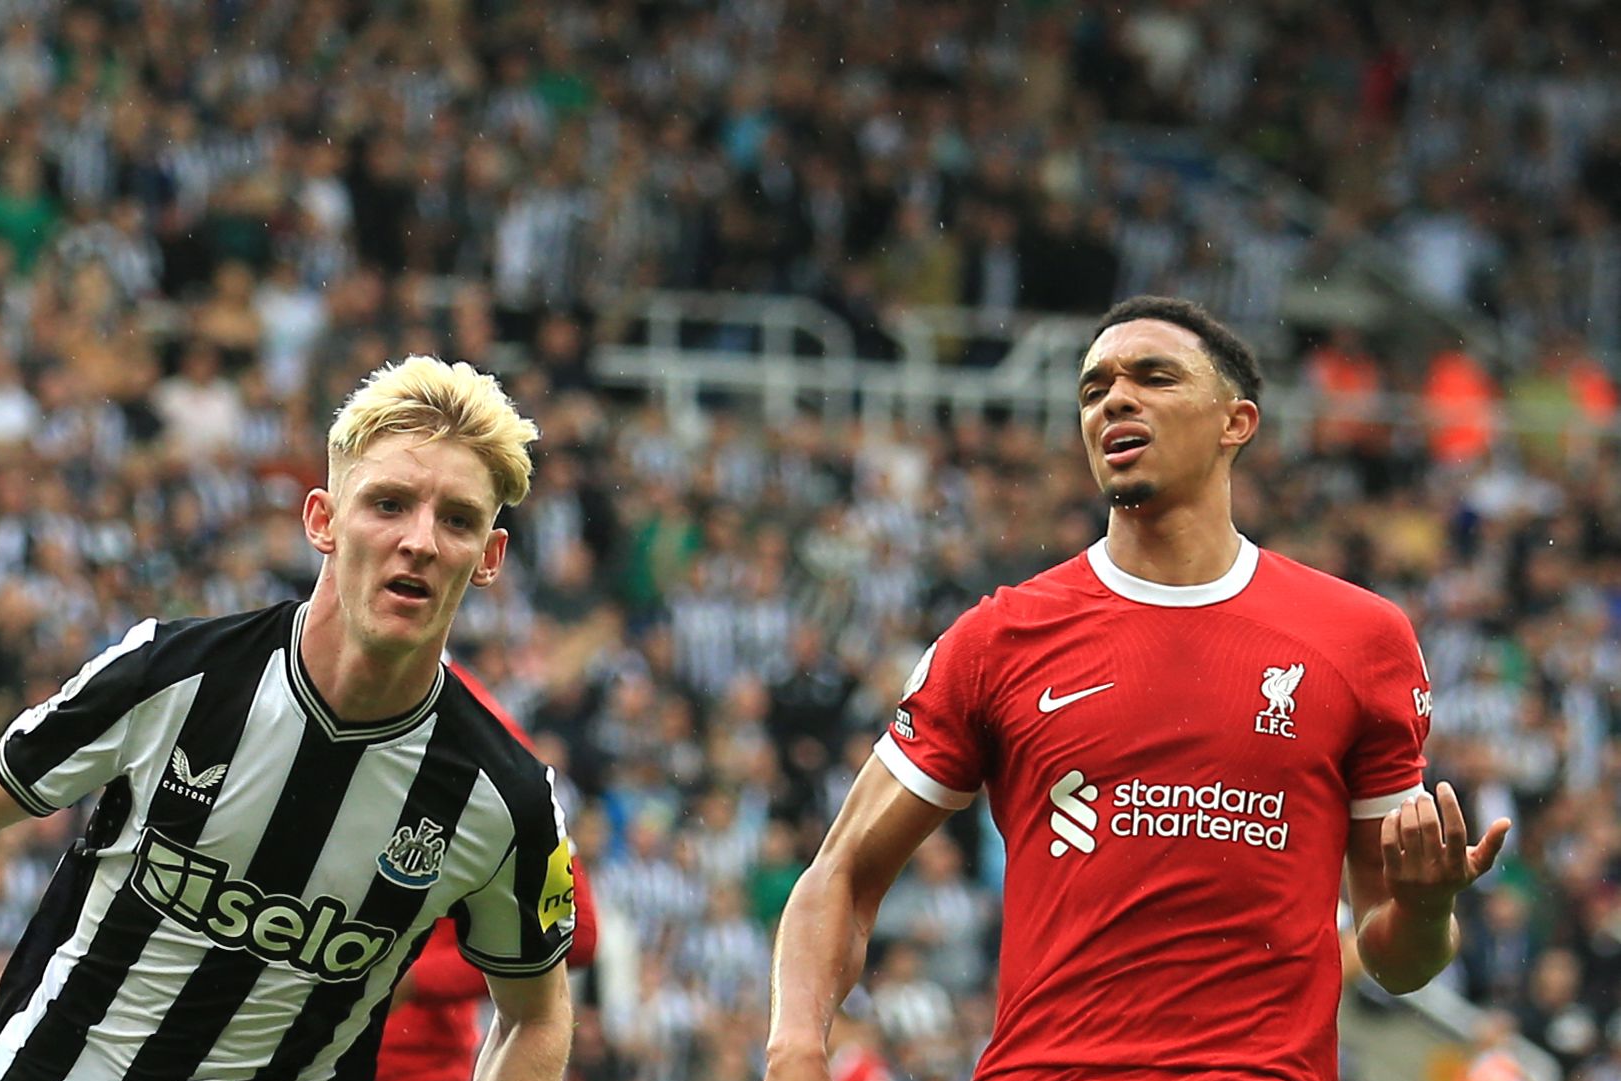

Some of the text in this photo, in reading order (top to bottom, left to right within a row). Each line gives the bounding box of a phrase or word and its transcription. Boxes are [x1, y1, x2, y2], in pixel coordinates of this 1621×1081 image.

[1254, 715, 1297, 740] L.F.C.
[162, 779, 213, 806] CASTORE
[1112, 778, 1285, 820] standard
[1110, 807, 1289, 851] chartered
[207, 889, 385, 973] sela
